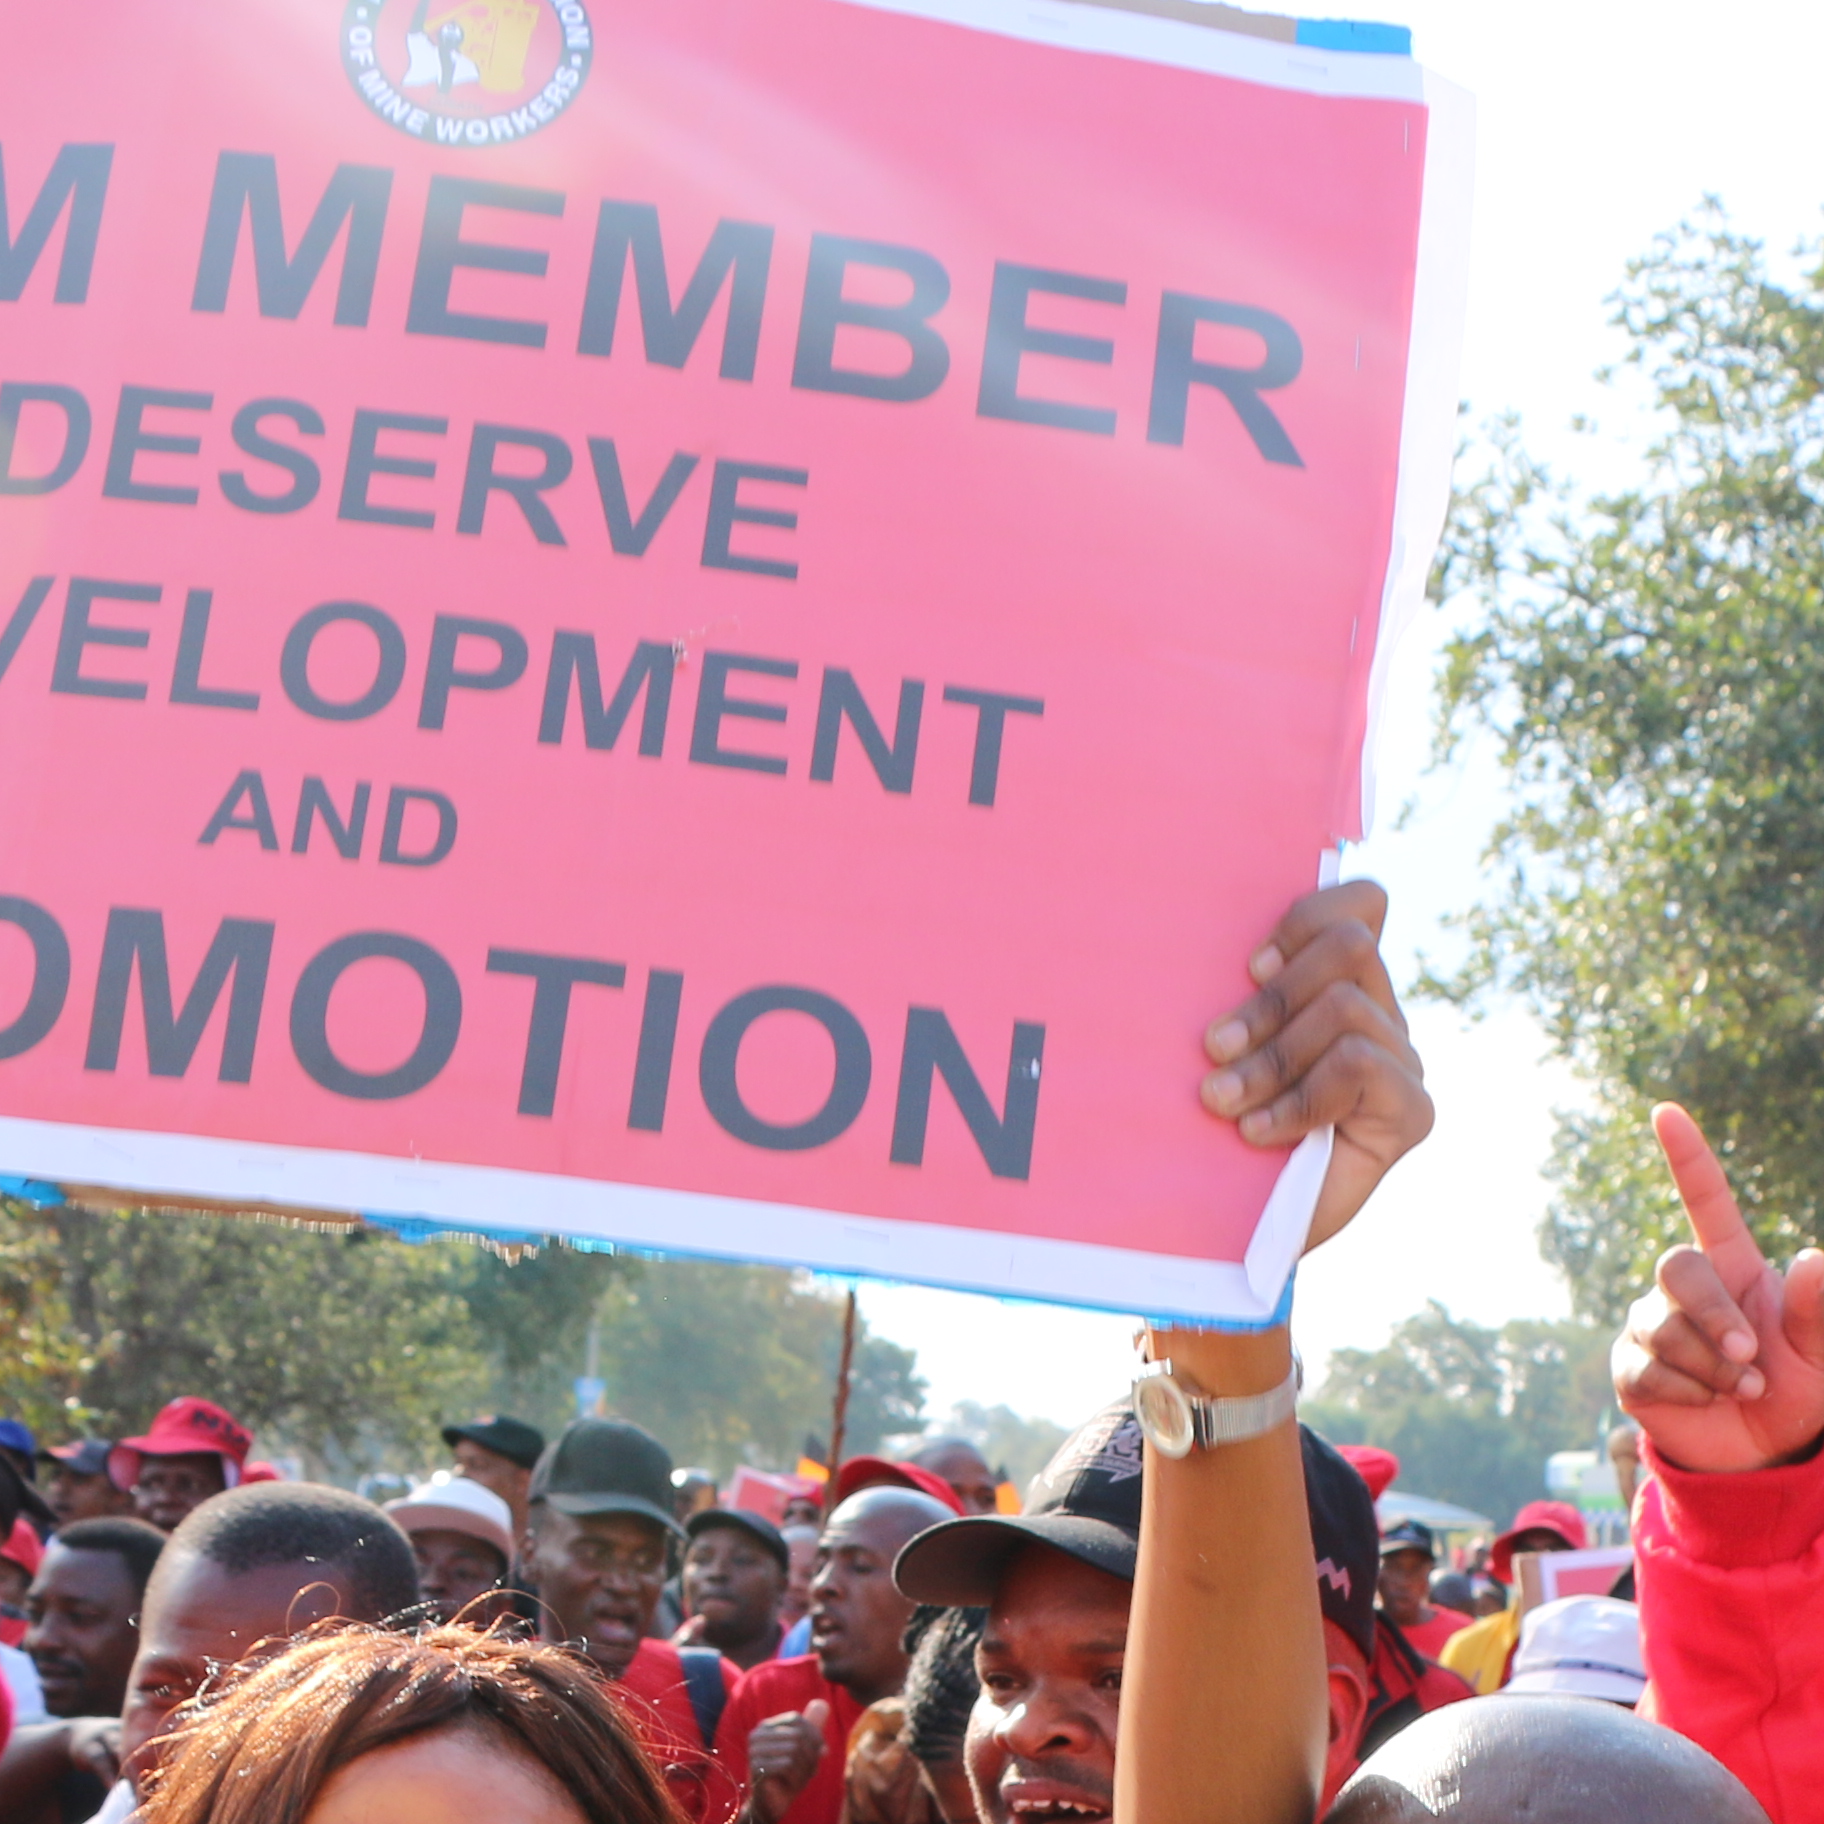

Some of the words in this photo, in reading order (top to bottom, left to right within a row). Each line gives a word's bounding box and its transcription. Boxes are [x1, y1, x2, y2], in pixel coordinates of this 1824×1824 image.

[358, 68, 430, 136] MINE
[435, 65, 580, 145] WORKERS
[191, 149, 1310, 469] MEMBER
[196, 767, 462, 867] AND
